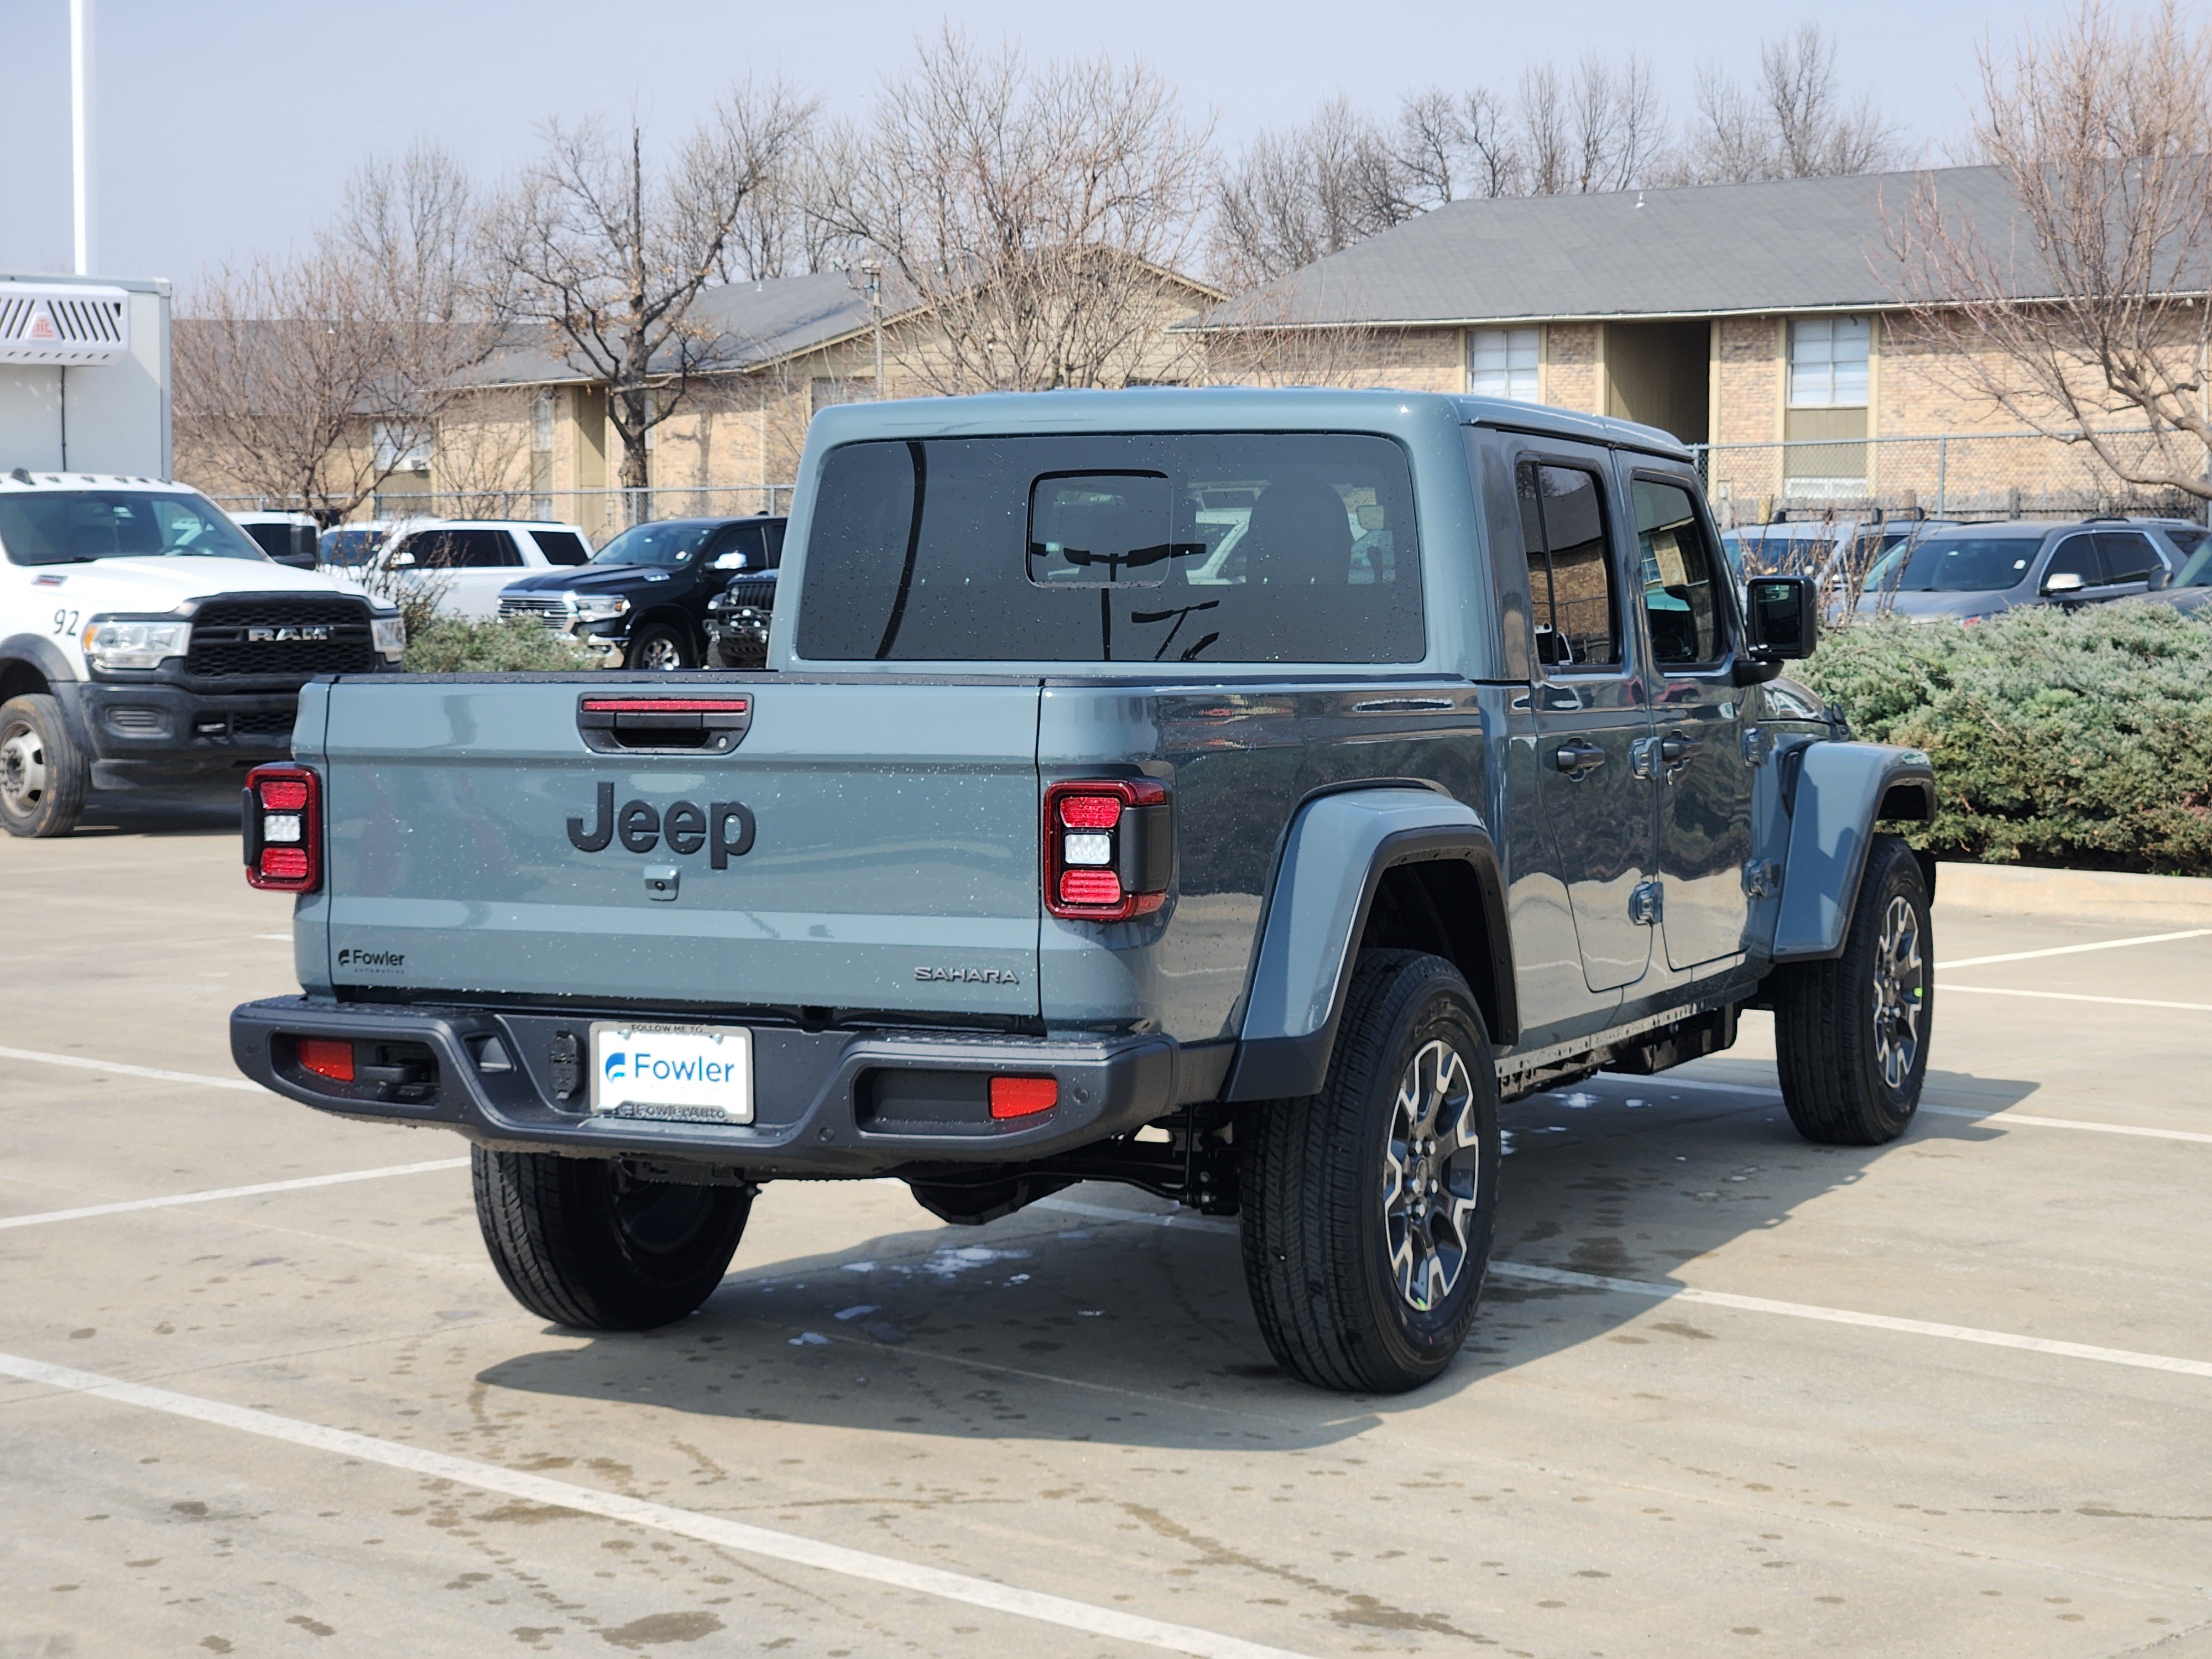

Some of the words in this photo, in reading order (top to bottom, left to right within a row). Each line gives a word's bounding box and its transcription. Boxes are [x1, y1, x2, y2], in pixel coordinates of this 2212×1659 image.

[53, 609, 79, 635] 92
[248, 628, 328, 642] RAM
[566, 781, 756, 870] Jeep
[353, 950, 405, 966] Fowler
[914, 967, 1019, 984] SAHARA
[635, 1053, 735, 1083] Fowler
